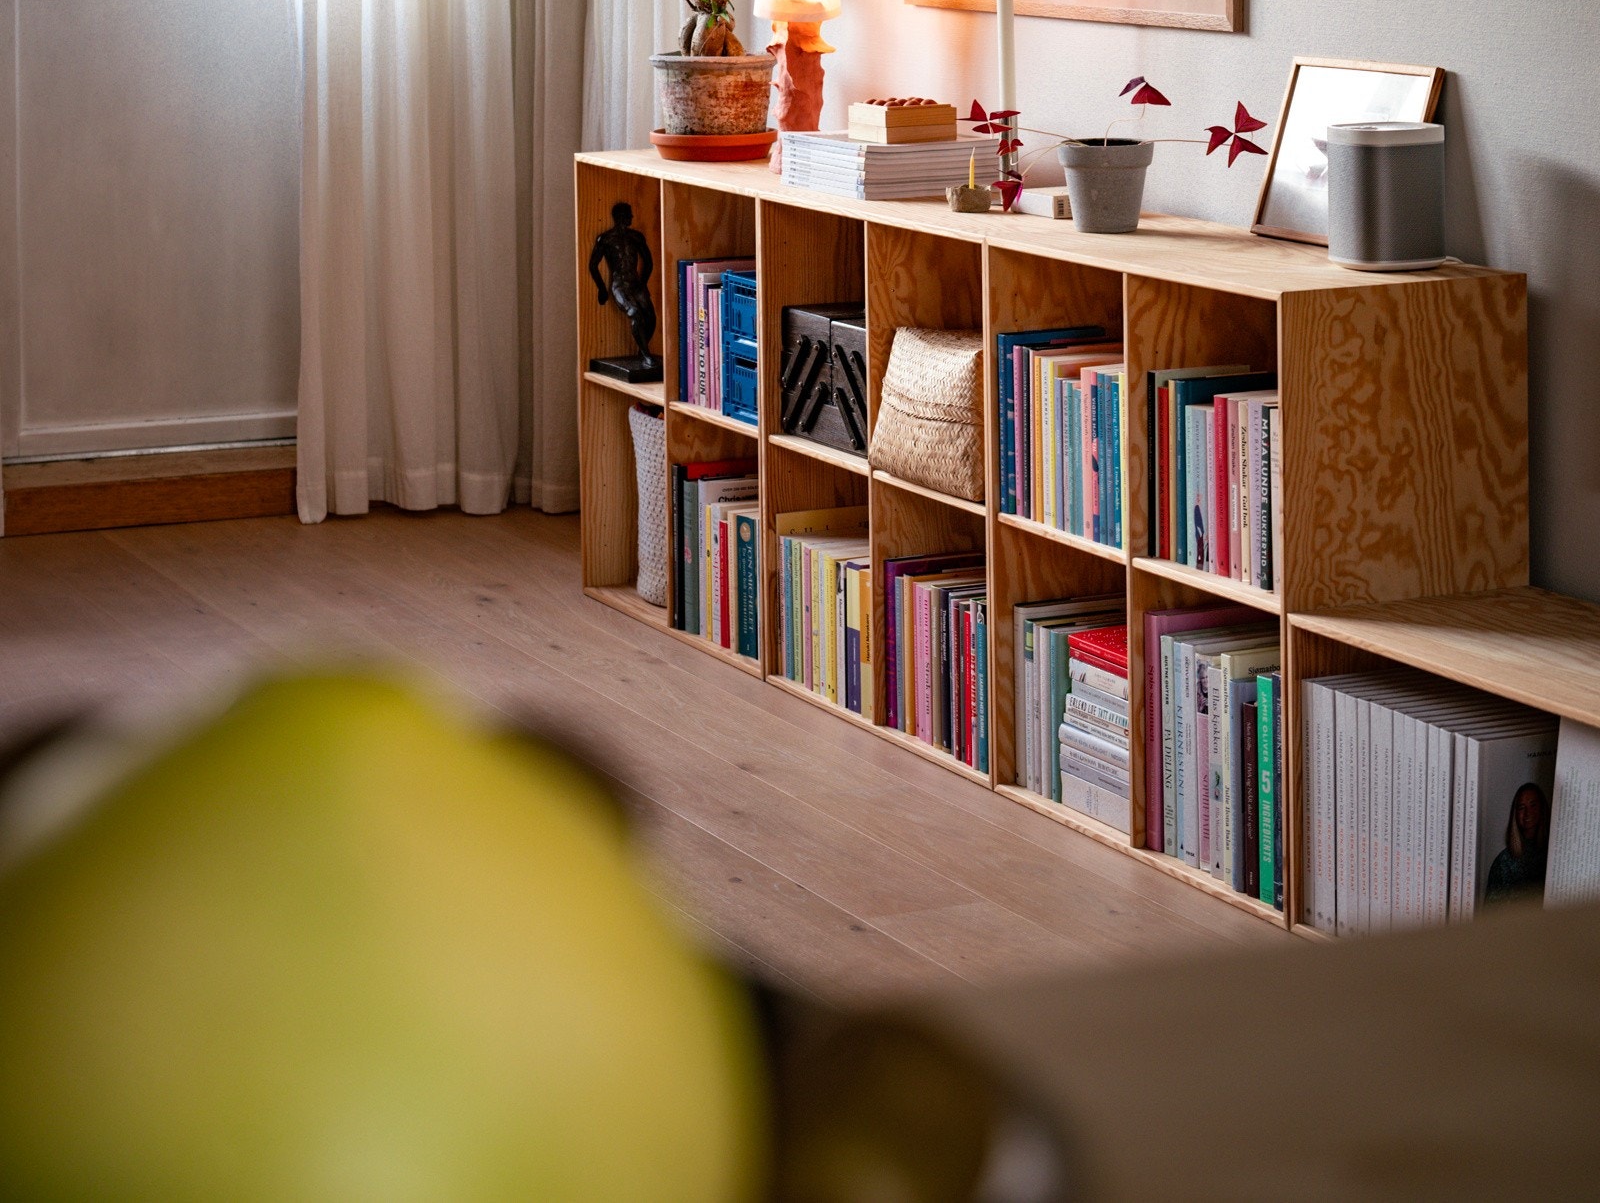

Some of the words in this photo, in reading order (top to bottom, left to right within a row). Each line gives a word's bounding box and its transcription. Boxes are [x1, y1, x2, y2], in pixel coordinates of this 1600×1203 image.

[699, 353, 705, 368] TO
[1261, 418, 1269, 452] MAJA
[1248, 664, 1281, 675] Sjømatbo
[1069, 697, 1087, 712] ERLEND
[1164, 729, 1172, 742] PÅ
[1177, 705, 1185, 800] KJERNESUNT
[1164, 746, 1172, 789] DELING
[1261, 769, 1271, 794] 5
[1202, 774, 1210, 811] SOPHIE
[1262, 800, 1271, 863] INGREDIENTS
